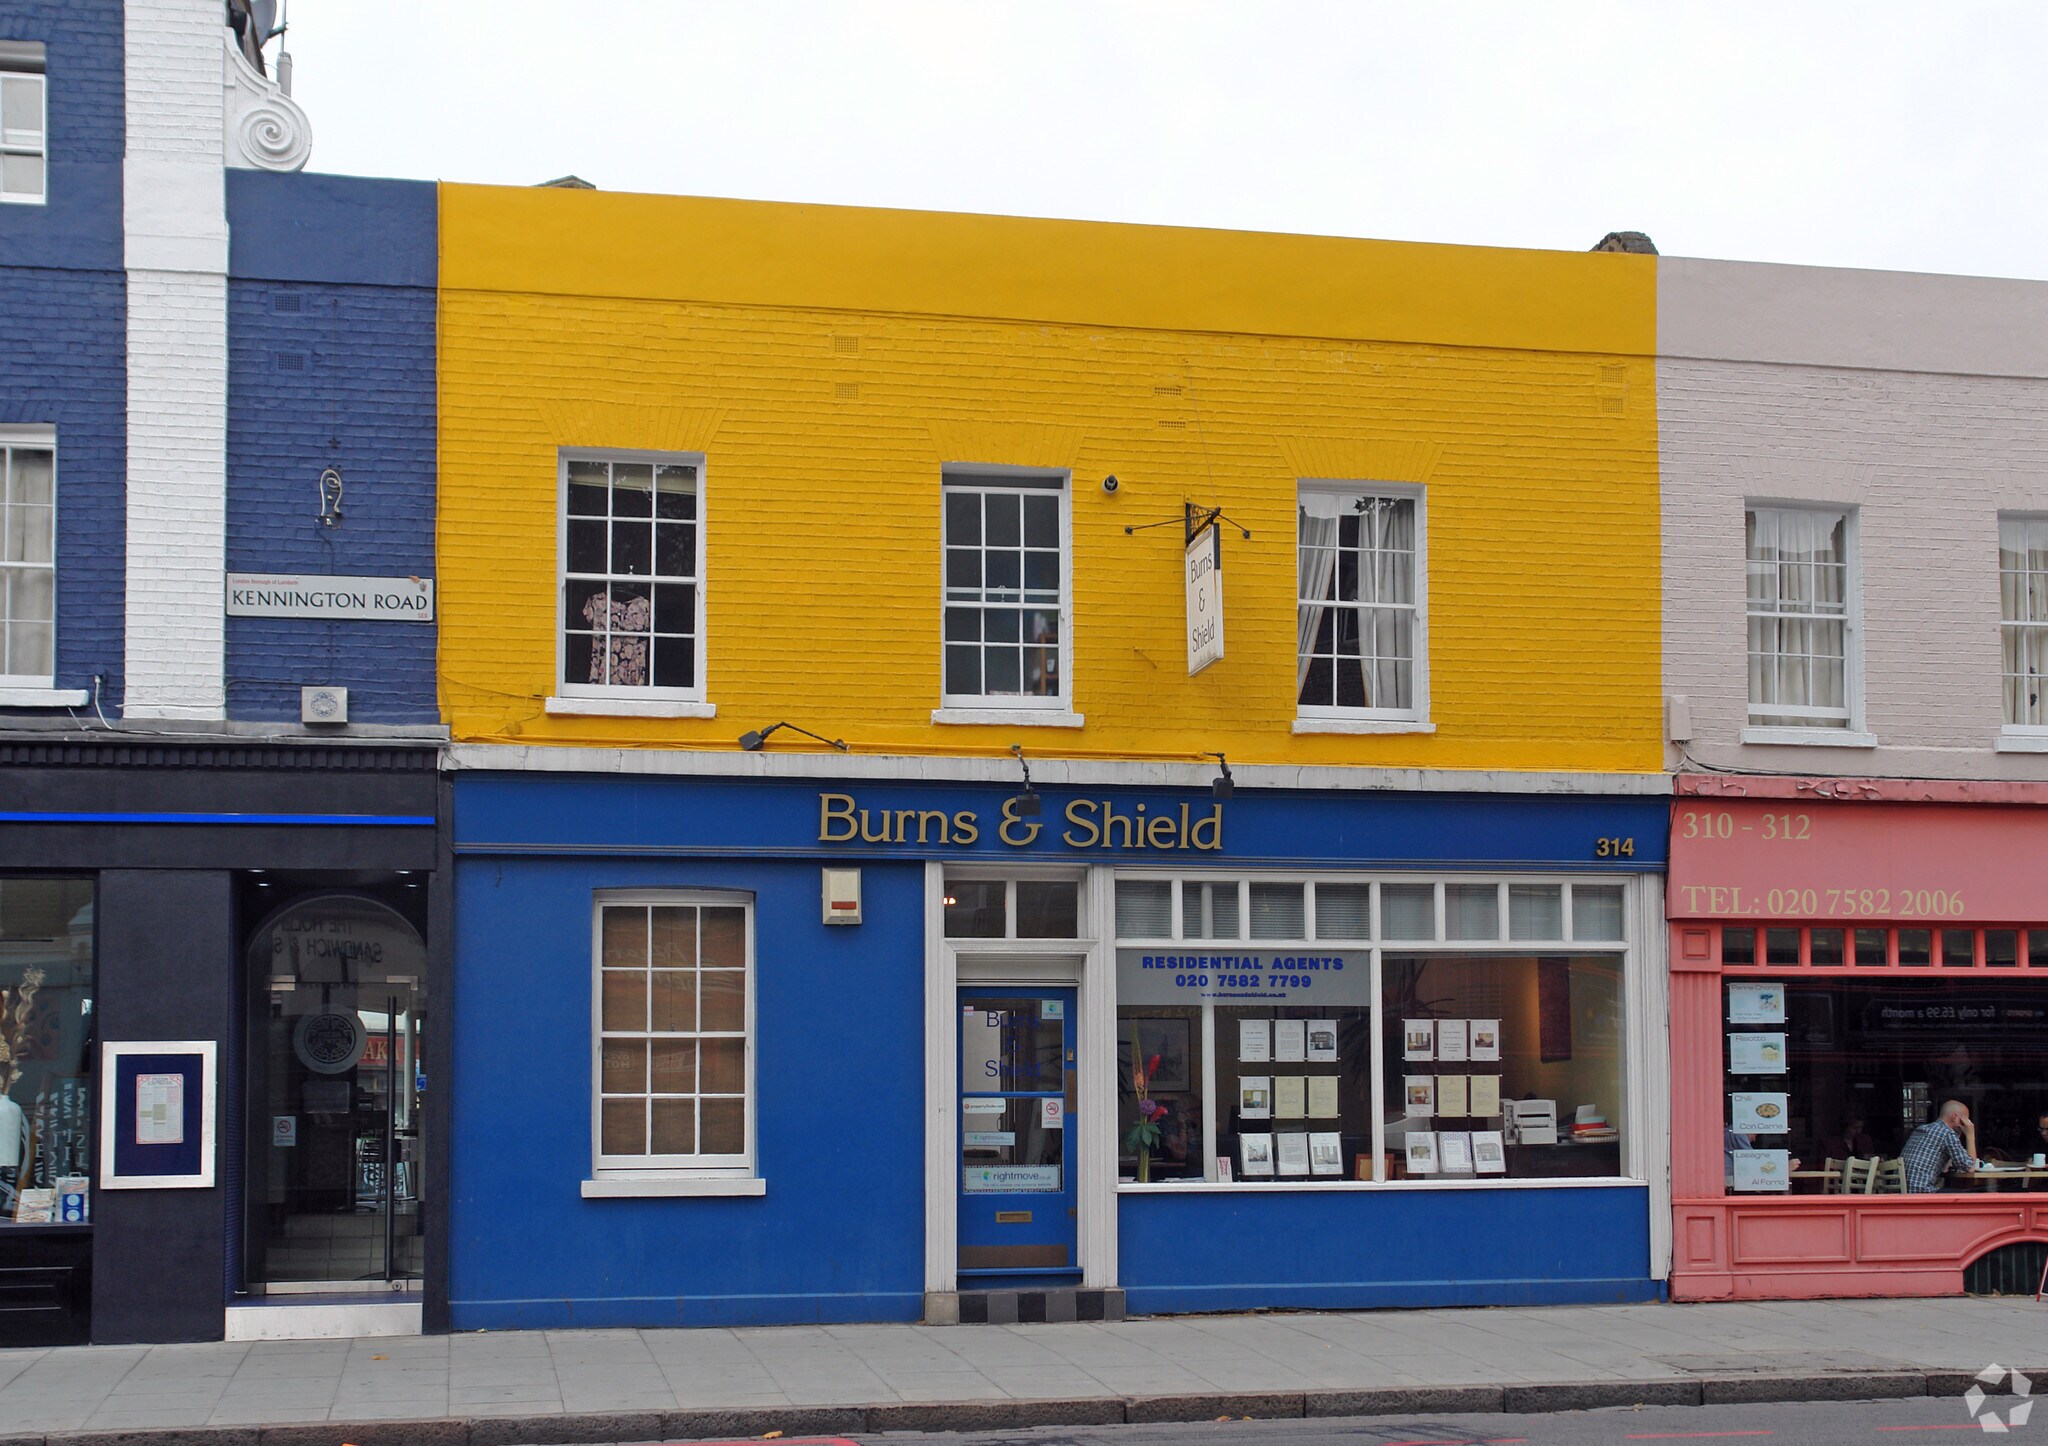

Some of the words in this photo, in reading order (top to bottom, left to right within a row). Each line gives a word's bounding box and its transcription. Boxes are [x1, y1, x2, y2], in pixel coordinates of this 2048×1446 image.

[1190, 553, 1213, 584] Burns
[232, 590, 367, 609] KENNINGTON
[373, 594, 428, 610] ROAD
[1198, 587, 1205, 612] &
[1192, 616, 1215, 653] Shield
[817, 792, 979, 845] Burns
[998, 796, 1044, 847] &
[1061, 798, 1223, 851] Shield
[1682, 812, 1734, 840] 310
[1761, 813, 1812, 840] 312
[1596, 837, 1635, 857] 314
[1680, 884, 1760, 915] TEL:
[1766, 888, 1818, 915] 020
[1825, 888, 1892, 916] 7582
[1898, 889, 1965, 917] 2006
[1142, 956, 1264, 970] RESIDENTIAL
[1271, 957, 1344, 971] AGENTS
[1175, 974, 1208, 987] 020
[1217, 974, 1260, 987] 7582
[1268, 975, 1312, 988] 7799
